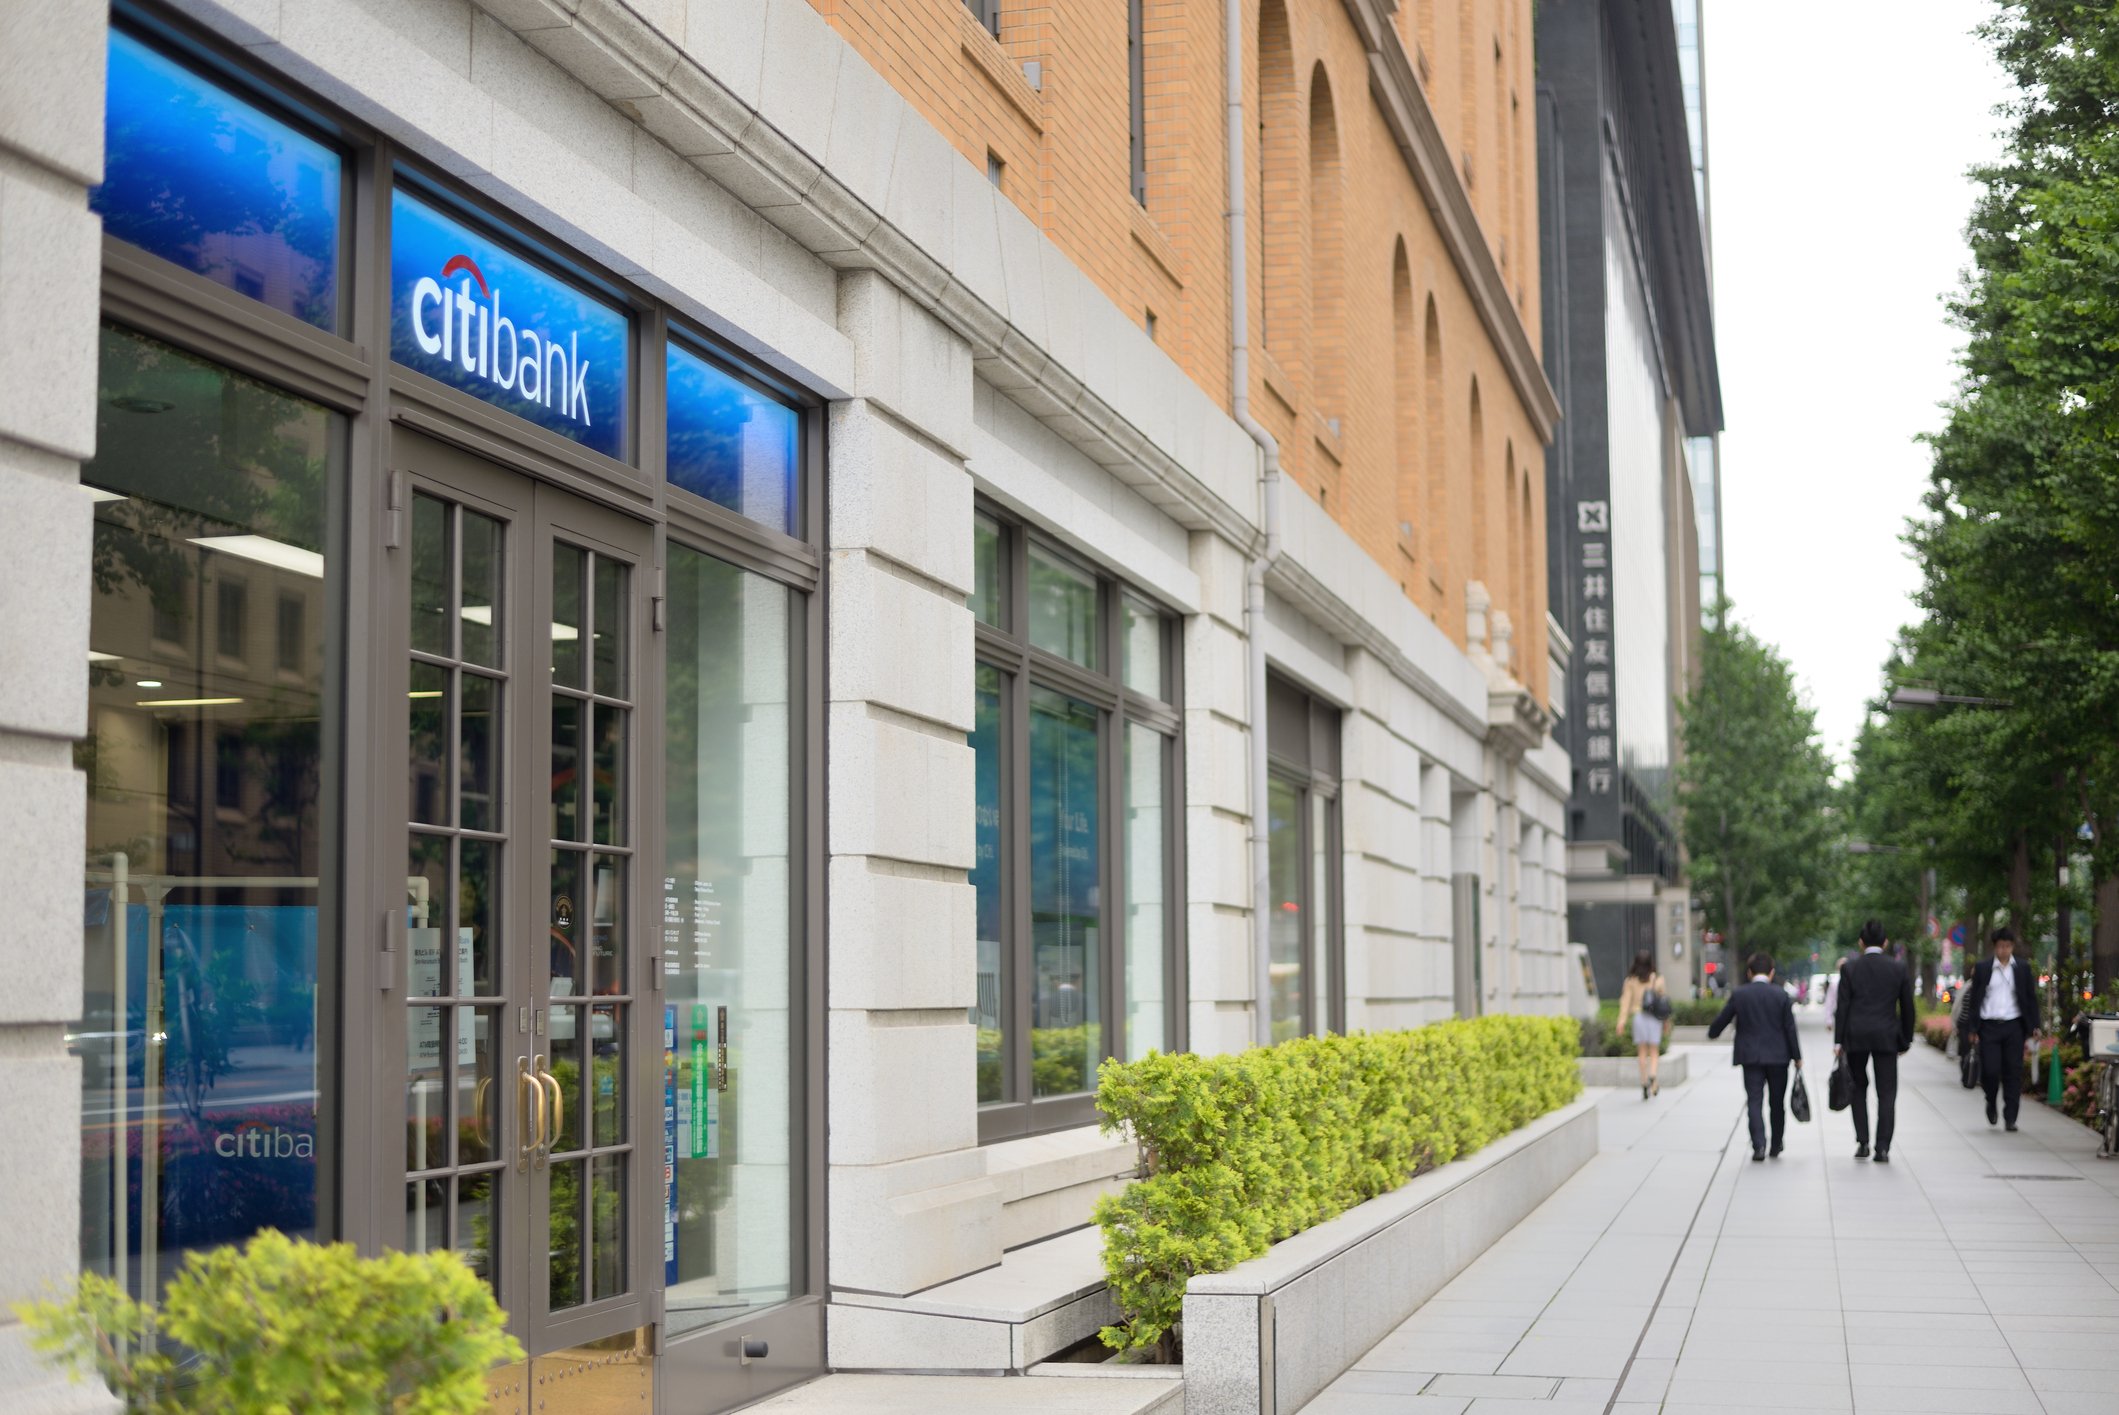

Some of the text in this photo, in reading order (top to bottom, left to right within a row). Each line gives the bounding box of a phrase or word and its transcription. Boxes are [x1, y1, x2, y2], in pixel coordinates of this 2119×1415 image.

[412, 276, 591, 426] citibank
[1583, 543, 1611, 794] 三井住友信託銀行
